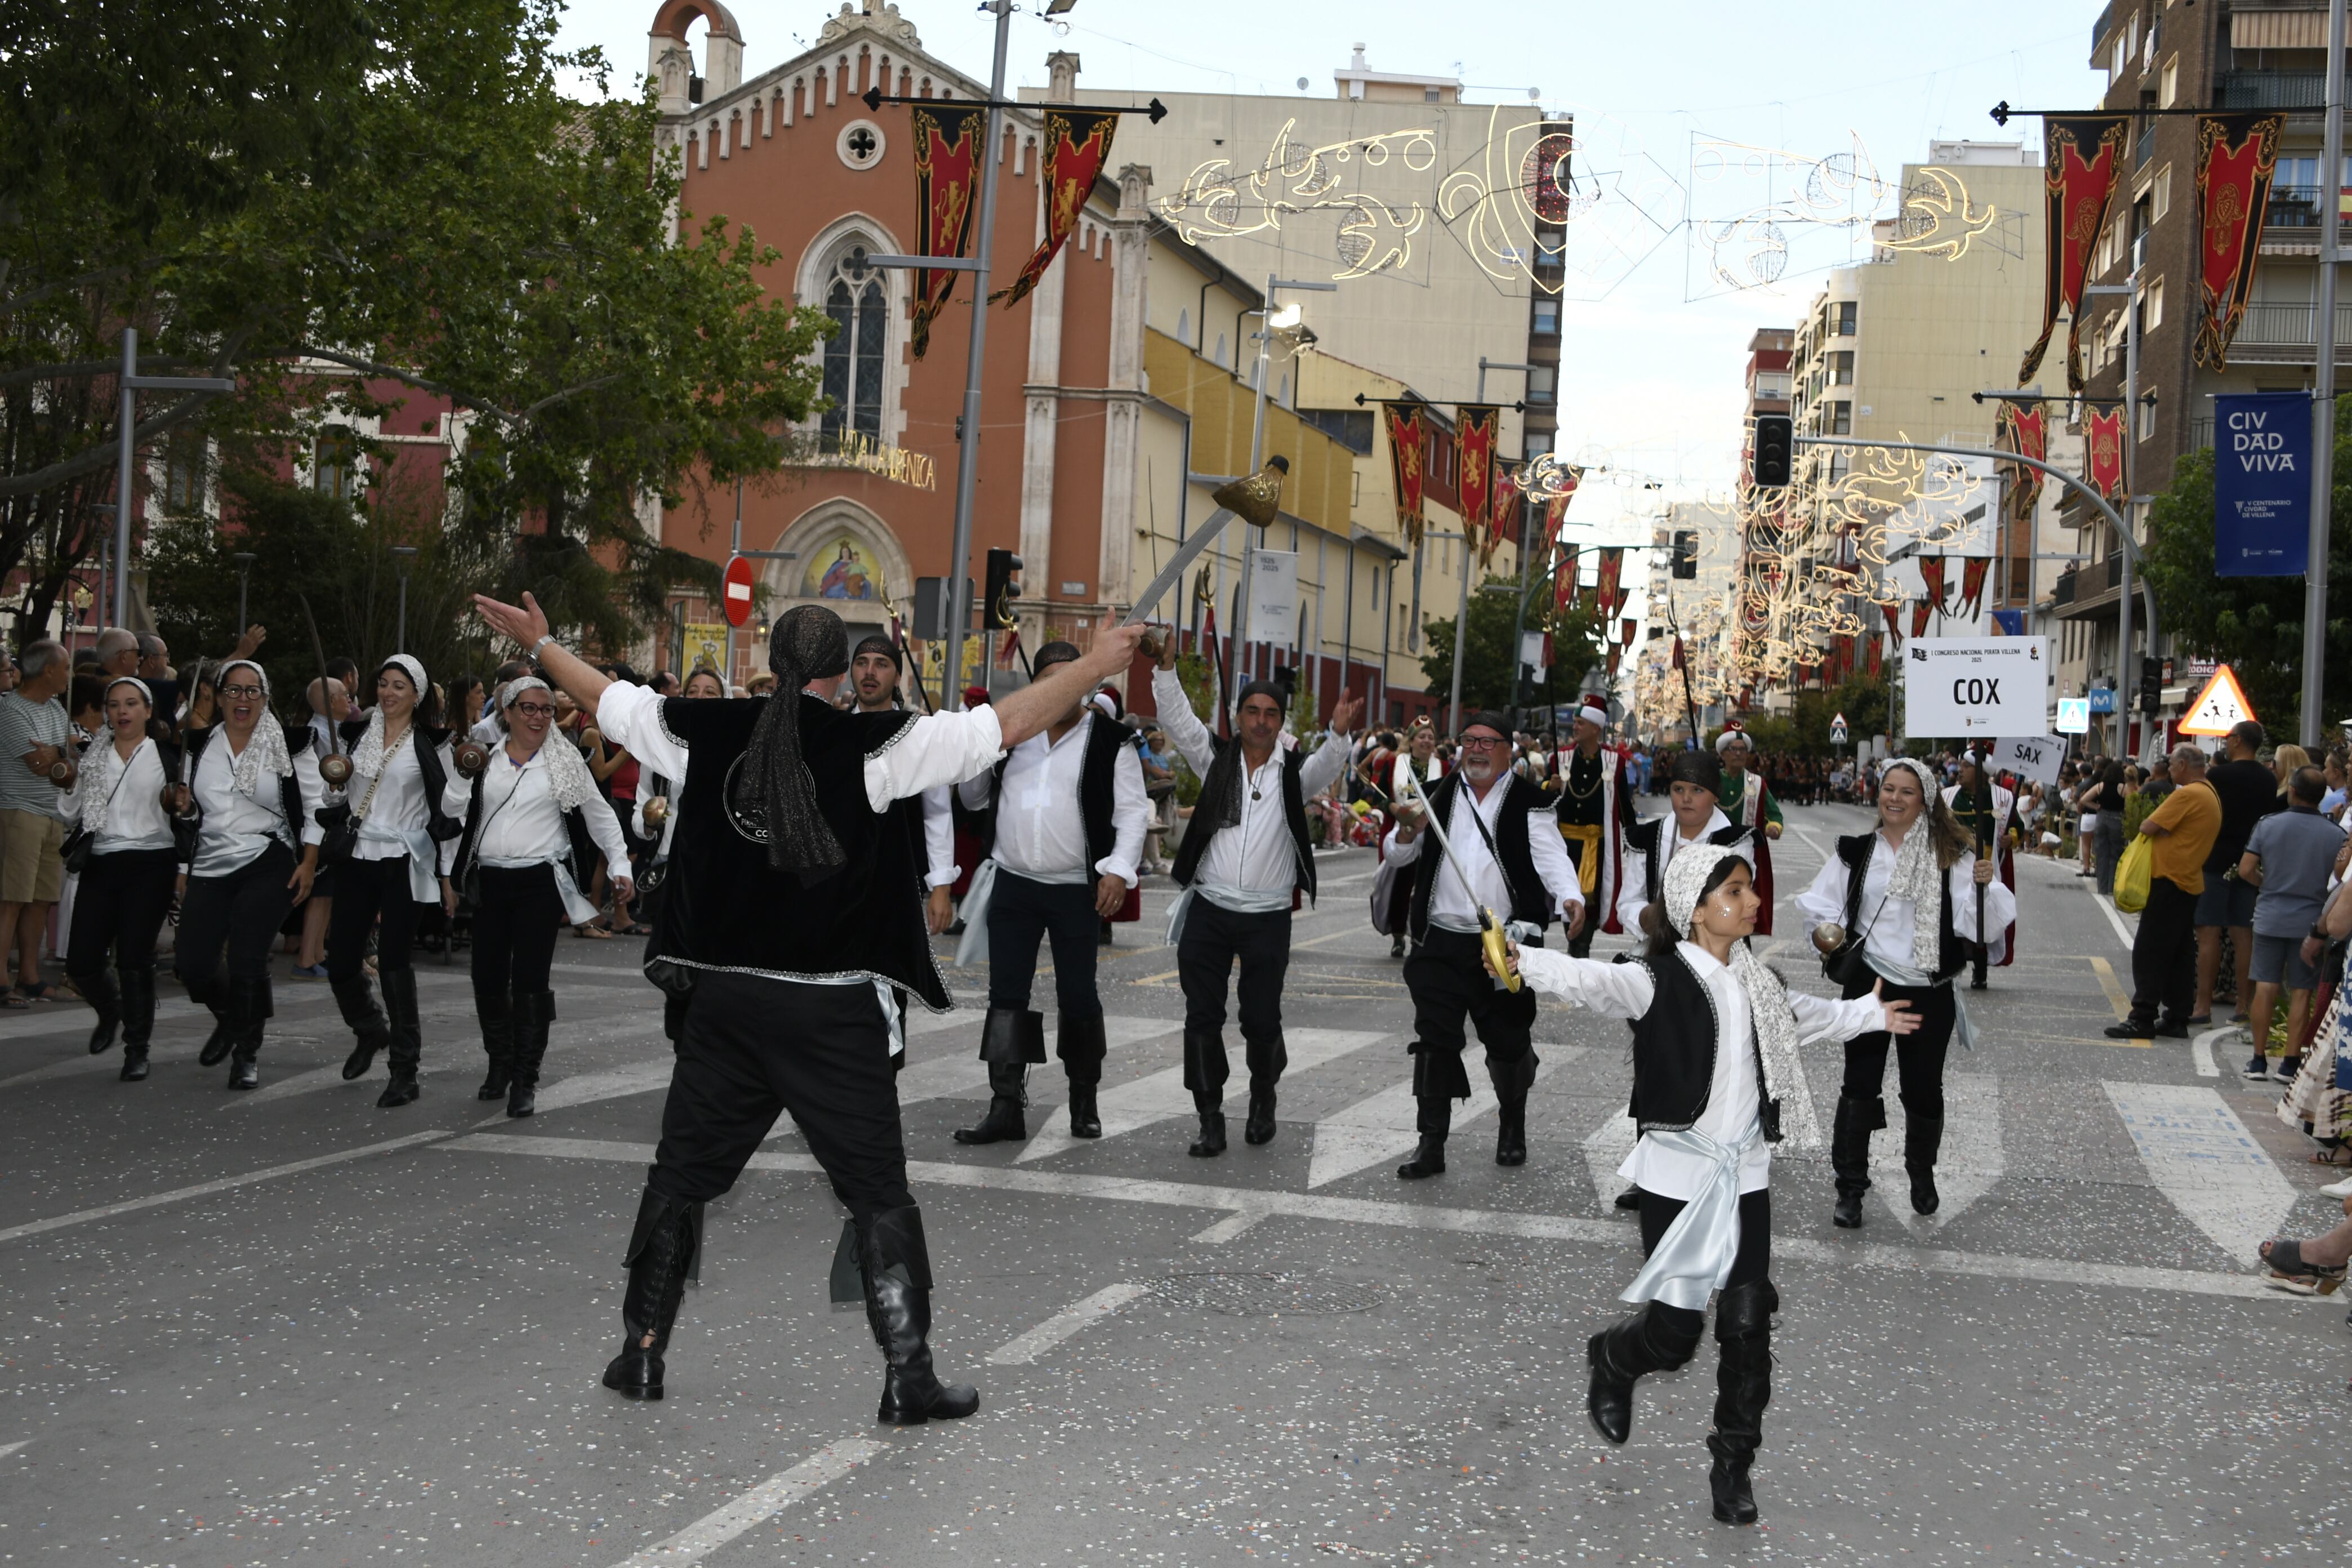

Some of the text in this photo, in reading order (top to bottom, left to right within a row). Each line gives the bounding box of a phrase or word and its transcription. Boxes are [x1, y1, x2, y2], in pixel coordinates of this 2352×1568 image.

[2228, 412, 2267, 430] CIV
[2234, 433, 2283, 451] DAD
[2240, 453, 2295, 472] VIVA
[1262, 564, 1279, 572] 2025
[1953, 678, 2001, 705] COX
[2015, 743, 2042, 765] SAX
[358, 783, 376, 811] GUESS
